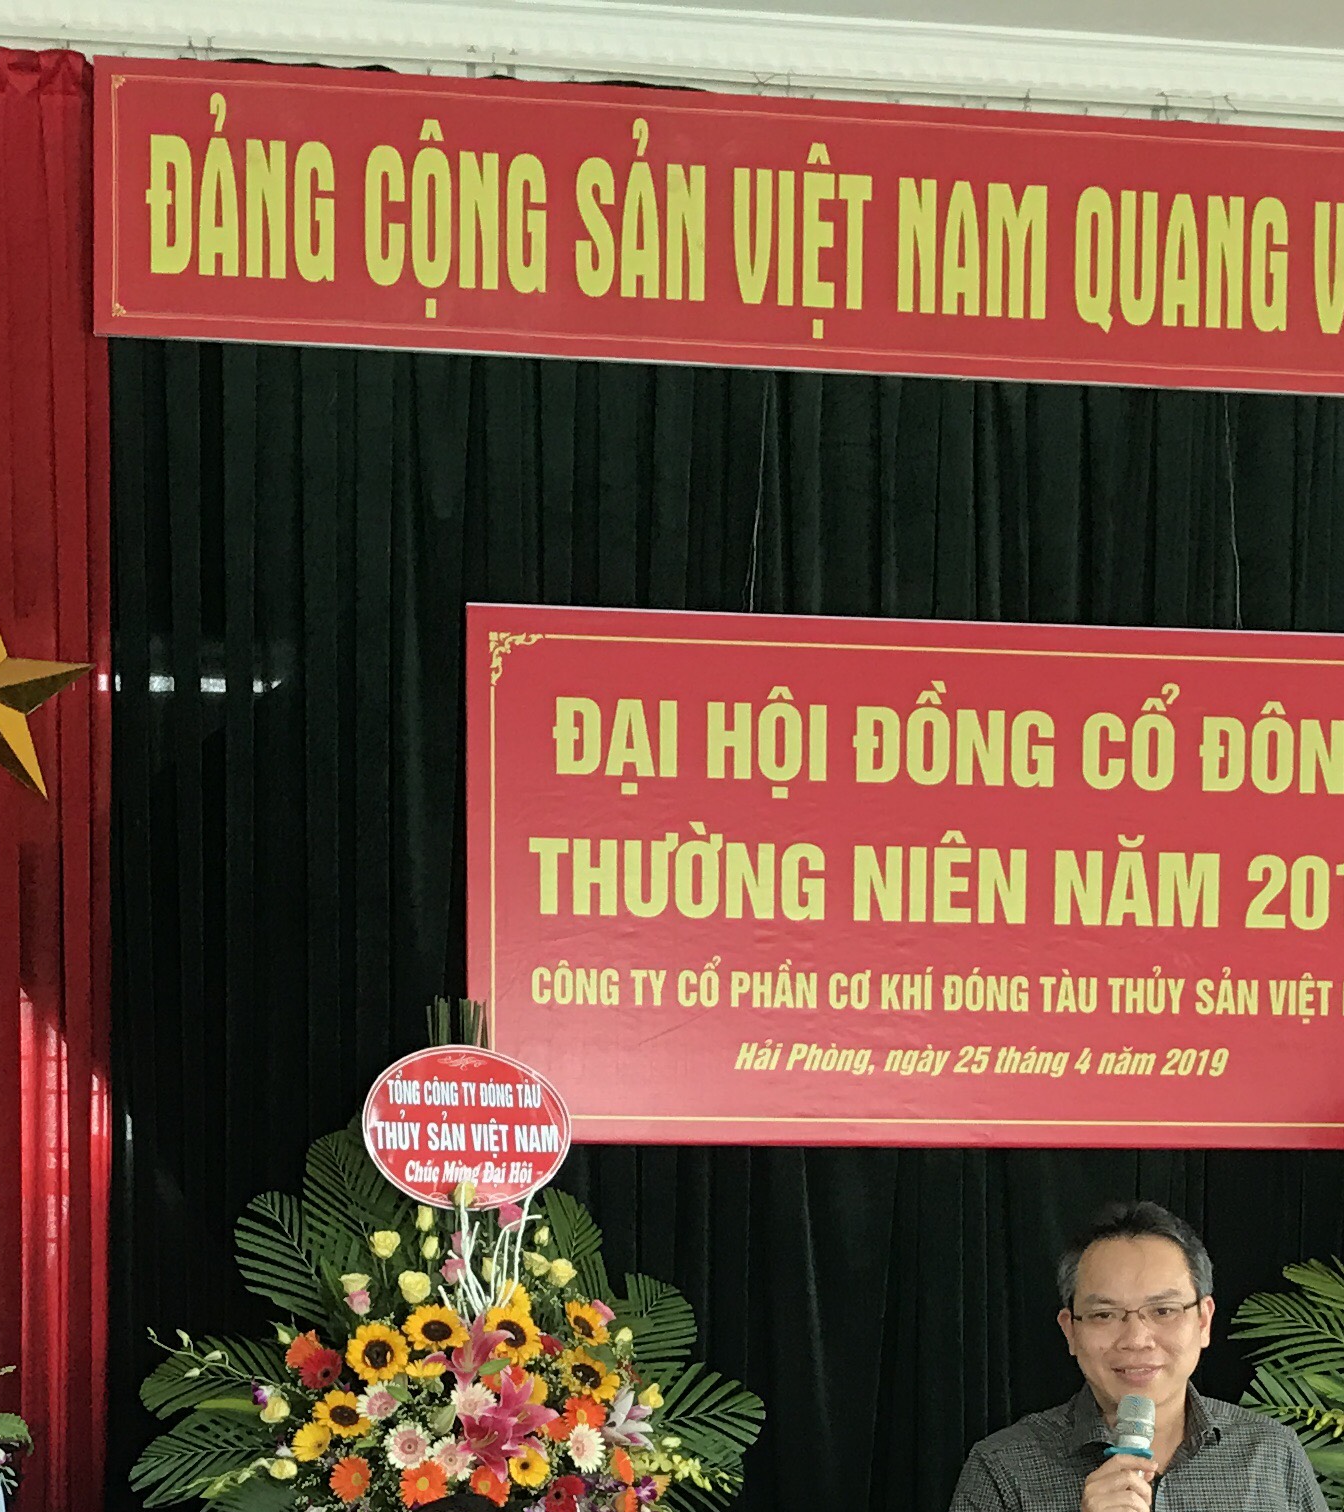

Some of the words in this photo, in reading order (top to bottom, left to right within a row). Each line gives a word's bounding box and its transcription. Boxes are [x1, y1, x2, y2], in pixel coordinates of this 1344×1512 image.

[146, 93, 336, 282] ĐẢNG
[365, 119, 548, 319] CỘNG
[576, 118, 706, 302] SẢN
[734, 143, 873, 339] VIỆT
[897, 177, 1048, 320] NAM
[1074, 186, 1288, 334] QUANG
[553, 697, 678, 795] ĐẠI
[707, 686, 827, 799] HỘI
[853, 680, 1055, 788] ĐỒNG
[1082, 683, 1180, 791] CỔ
[529, 821, 826, 922] THƯỜNG
[853, 830, 1027, 925] NIÊN
[1054, 834, 1221, 927] NĂM
[531, 961, 619, 1006] CÔNG
[631, 969, 665, 1006] TY
[678, 956, 722, 1008] CỔ
[730, 959, 818, 1010] PHẦN
[829, 969, 872, 1010] CƠ
[881, 967, 933, 1011] KHÍ
[943, 967, 1029, 1013] ĐÓNG
[1040, 967, 1098, 1013] TÀU
[1108, 966, 1185, 1015] THỦY
[1195, 967, 1258, 1016] SẢN
[1269, 973, 1333, 1024] VIỆT
[735, 1039, 778, 1072] Hải
[786, 1043, 874, 1076] Phòng,
[883, 1046, 945, 1077] ngày
[953, 1045, 991, 1074] 25
[994, 1047, 1067, 1080] tháng
[1074, 1050, 1091, 1072] 4
[1097, 1048, 1156, 1076] năm
[1160, 1049, 1229, 1078] 2019
[387, 1070, 420, 1105] TỔNG
[424, 1077, 458, 1106] CÔNG
[461, 1082, 477, 1107] TY
[480, 1078, 514, 1108] ĐÓNG
[516, 1079, 541, 1109] TÀU
[375, 1110, 421, 1150] THỦY
[427, 1111, 466, 1151] SẢN
[471, 1118, 509, 1158] VIỆT
[515, 1125, 558, 1153] NAM
[405, 1158, 440, 1183] Chúc
[441, 1160, 479, 1186] Mừng
[483, 1161, 506, 1188] Đại
[510, 1162, 533, 1188] Hội
